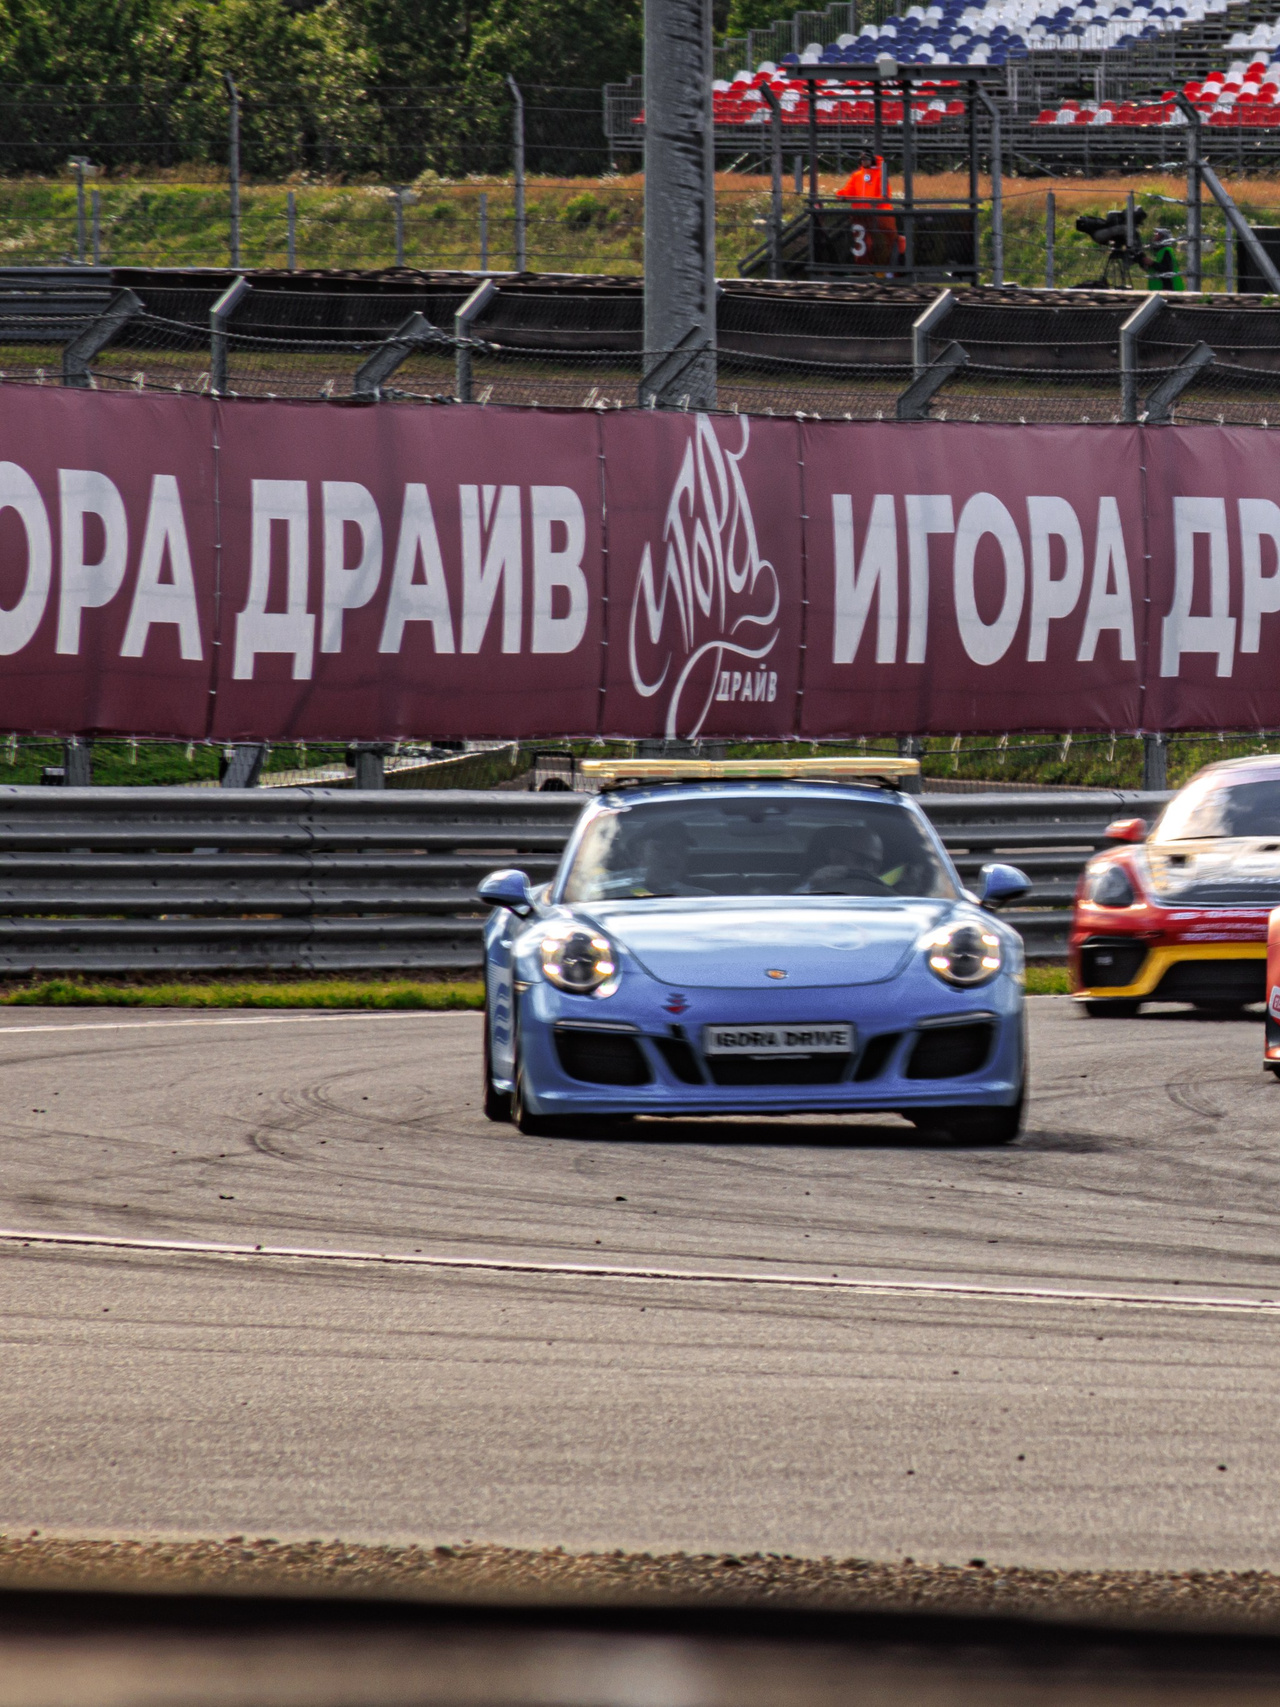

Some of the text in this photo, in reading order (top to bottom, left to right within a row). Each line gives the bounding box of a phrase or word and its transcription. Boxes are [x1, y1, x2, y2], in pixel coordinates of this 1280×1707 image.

[850, 224, 866, 256] 3
[232, 479, 589, 680] ДРАЙВ
[832, 491, 1137, 665] ИГОРА
[715, 664, 778, 703] ДРАЙВ
[716, 1030, 848, 1048] IGORA DRIVE
